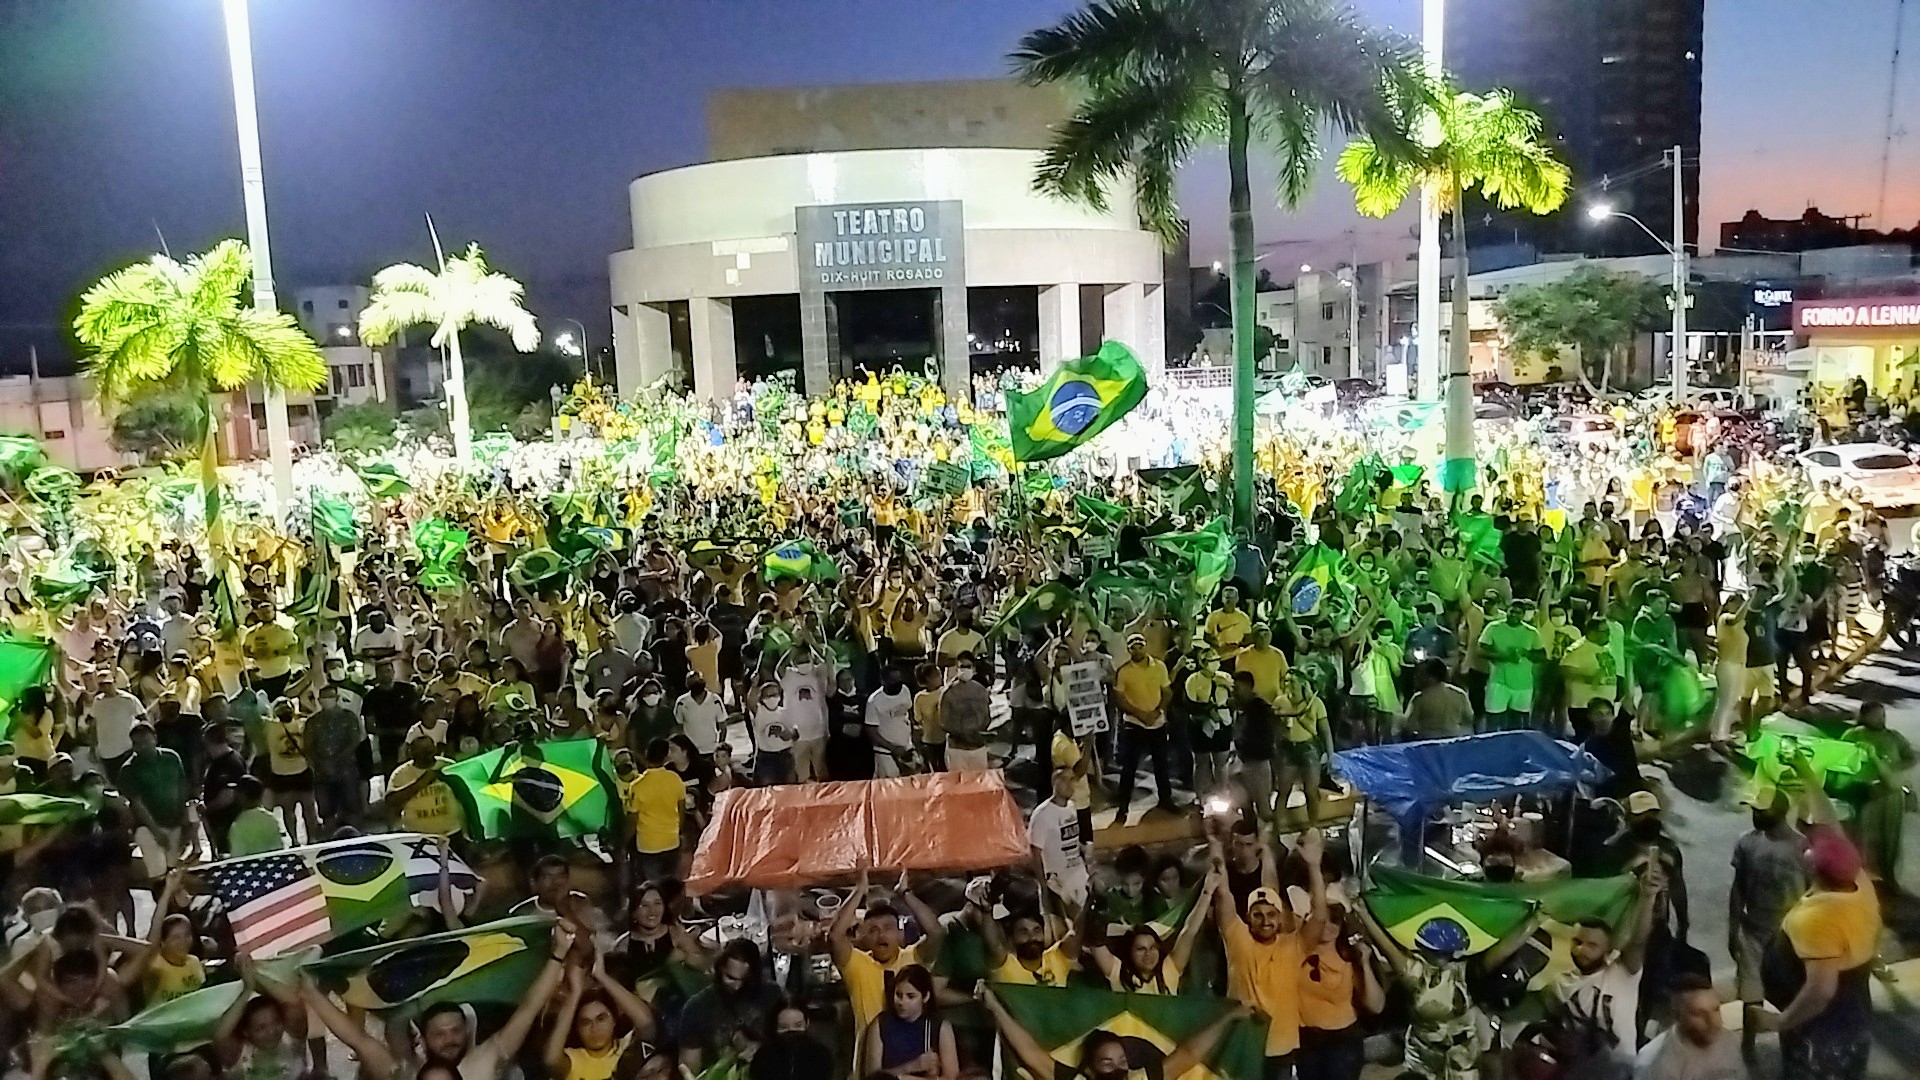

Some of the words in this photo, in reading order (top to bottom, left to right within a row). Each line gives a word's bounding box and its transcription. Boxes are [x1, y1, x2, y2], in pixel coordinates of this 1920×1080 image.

[833, 207, 925, 235] TEATRO
[814, 237, 947, 267] MUNICIPAL
[821, 270, 881, 283] DIX-HUIT
[886, 268, 943, 280] ROSADO
[1801, 306, 1855, 326] FORNO
[1855, 306, 1870, 326] A
